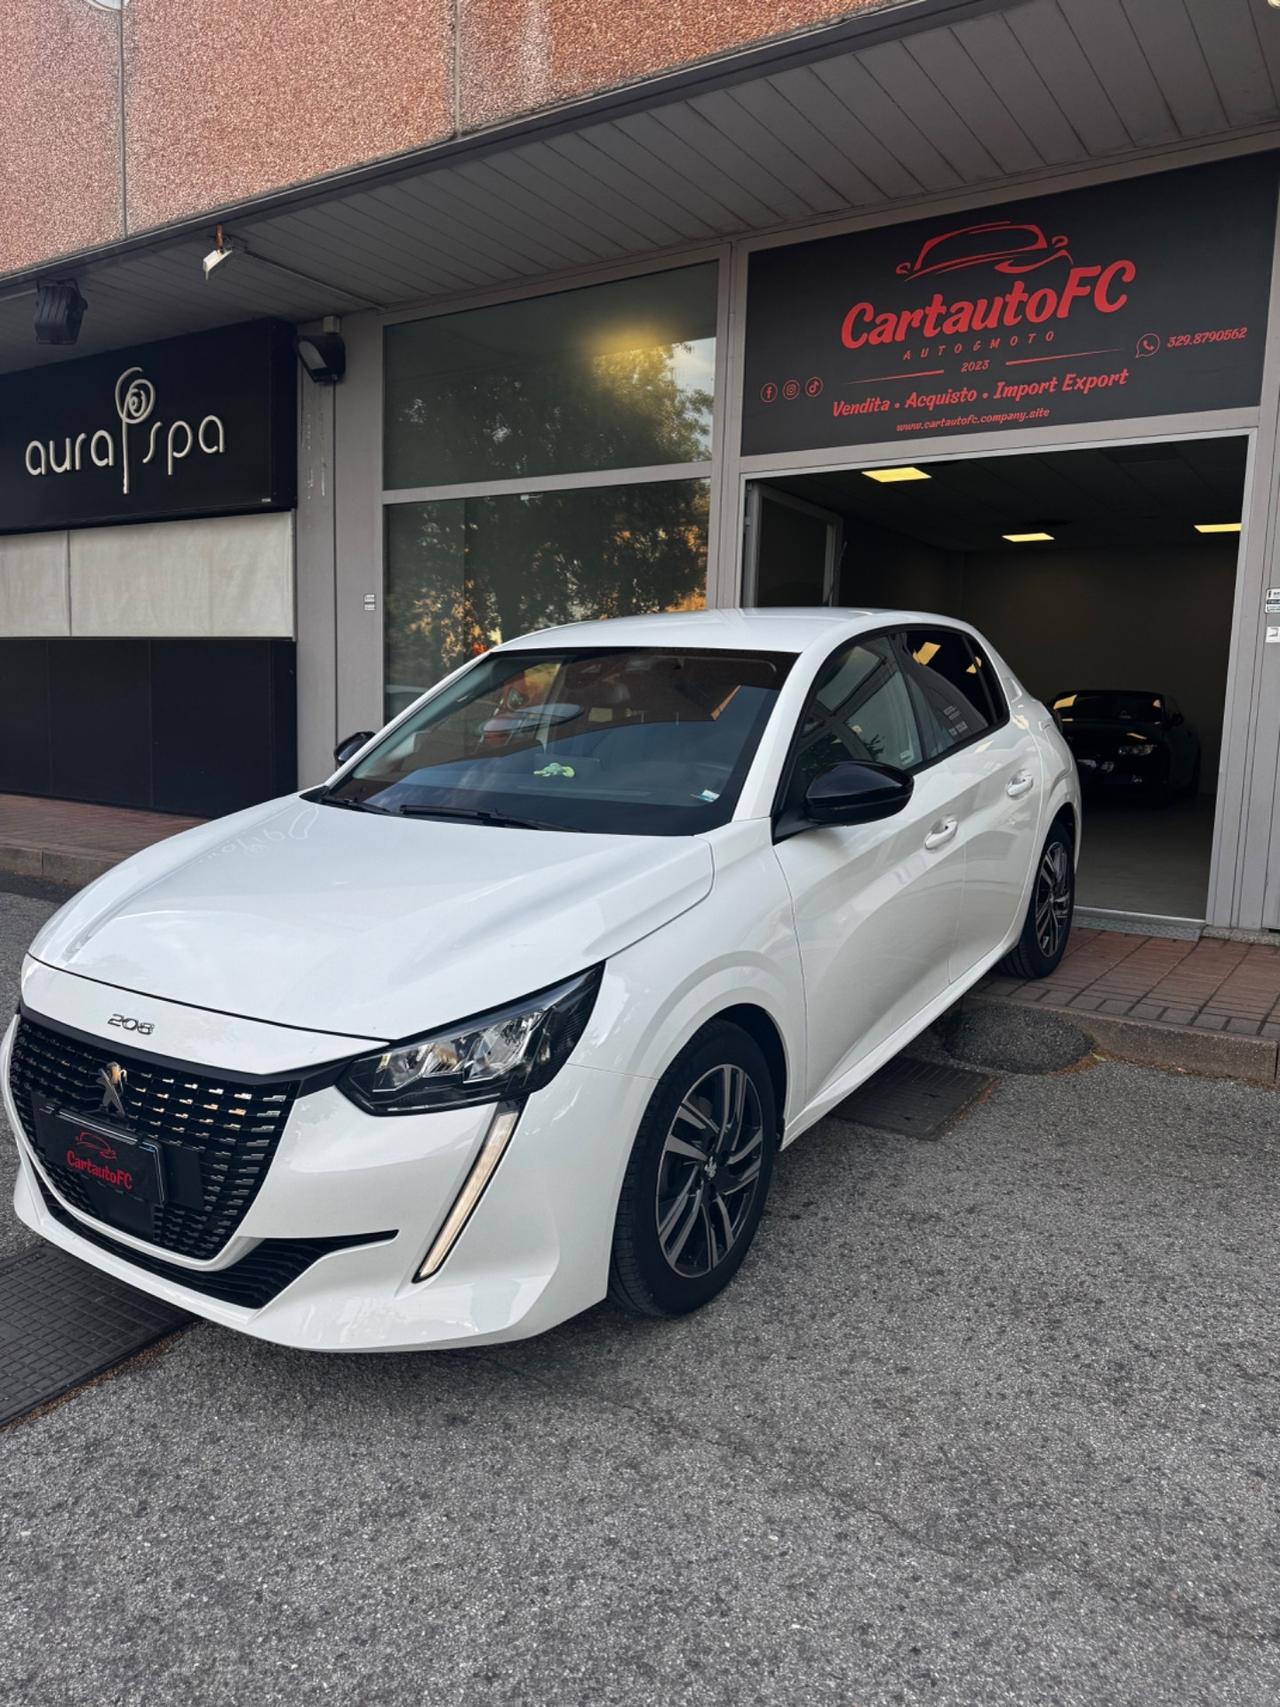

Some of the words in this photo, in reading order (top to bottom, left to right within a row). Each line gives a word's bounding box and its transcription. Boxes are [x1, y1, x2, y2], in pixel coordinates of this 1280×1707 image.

[841, 260, 1136, 349] CartautoFC
[960, 360, 991, 372] 2023
[832, 397, 891, 417] Vendita
[905, 388, 977, 410] Acquisto
[994, 378, 1057, 402] Import
[1062, 369, 1129, 394] Export
[895, 408, 1049, 431] www.cartautofc.company.site
[26, 430, 114, 475] aura
[143, 416, 224, 475] spa
[107, 1013, 155, 1035] 208
[67, 1150, 132, 1189] CartautoFC
